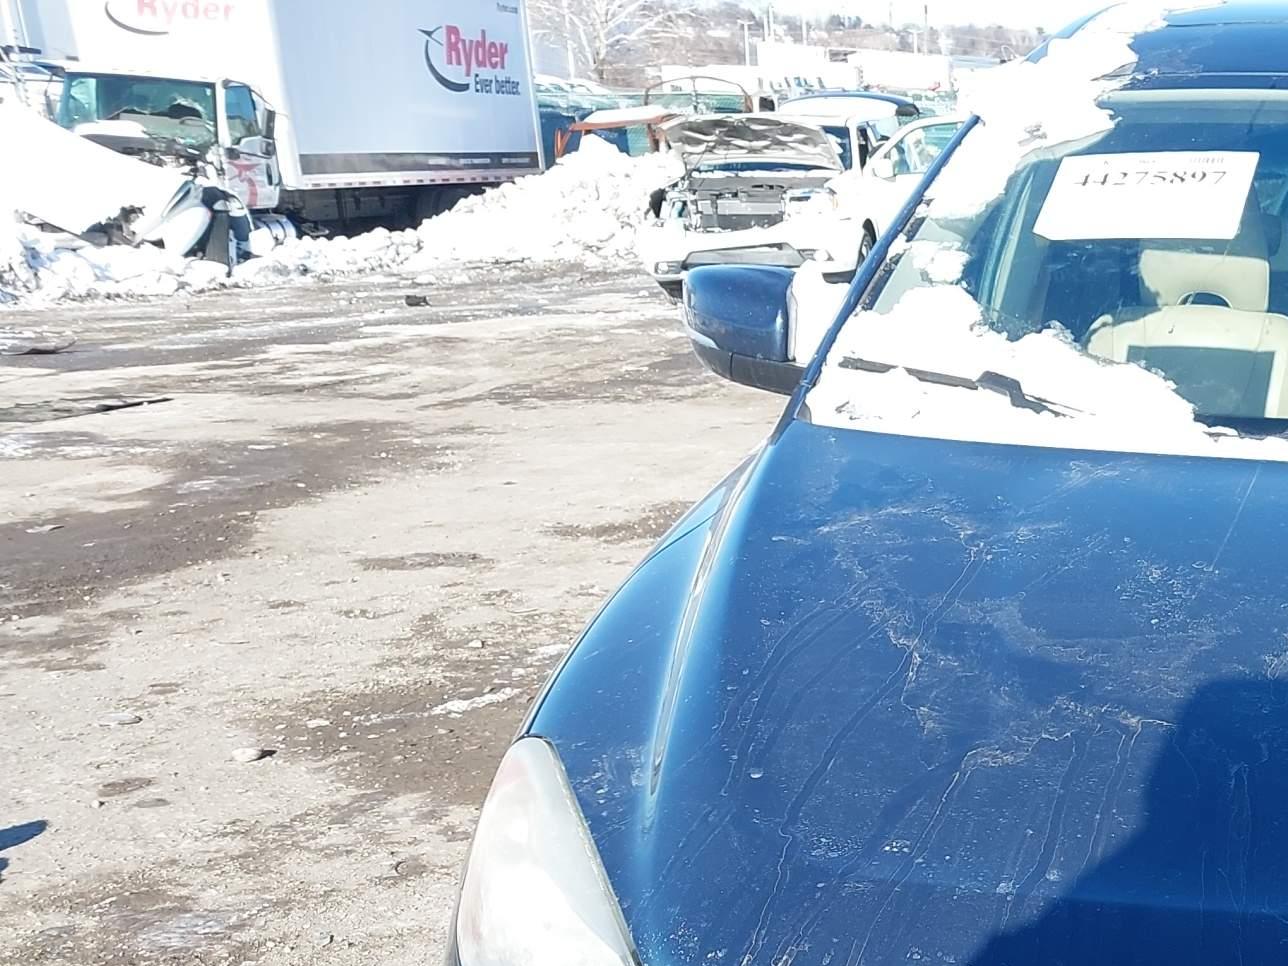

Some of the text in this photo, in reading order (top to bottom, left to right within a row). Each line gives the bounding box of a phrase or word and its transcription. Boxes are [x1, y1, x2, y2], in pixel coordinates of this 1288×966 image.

[136, 0, 236, 25] Ryder
[445, 25, 509, 77] Ryder
[474, 73, 521, 96] Ever better.
[1073, 170, 1228, 187] 44275897
